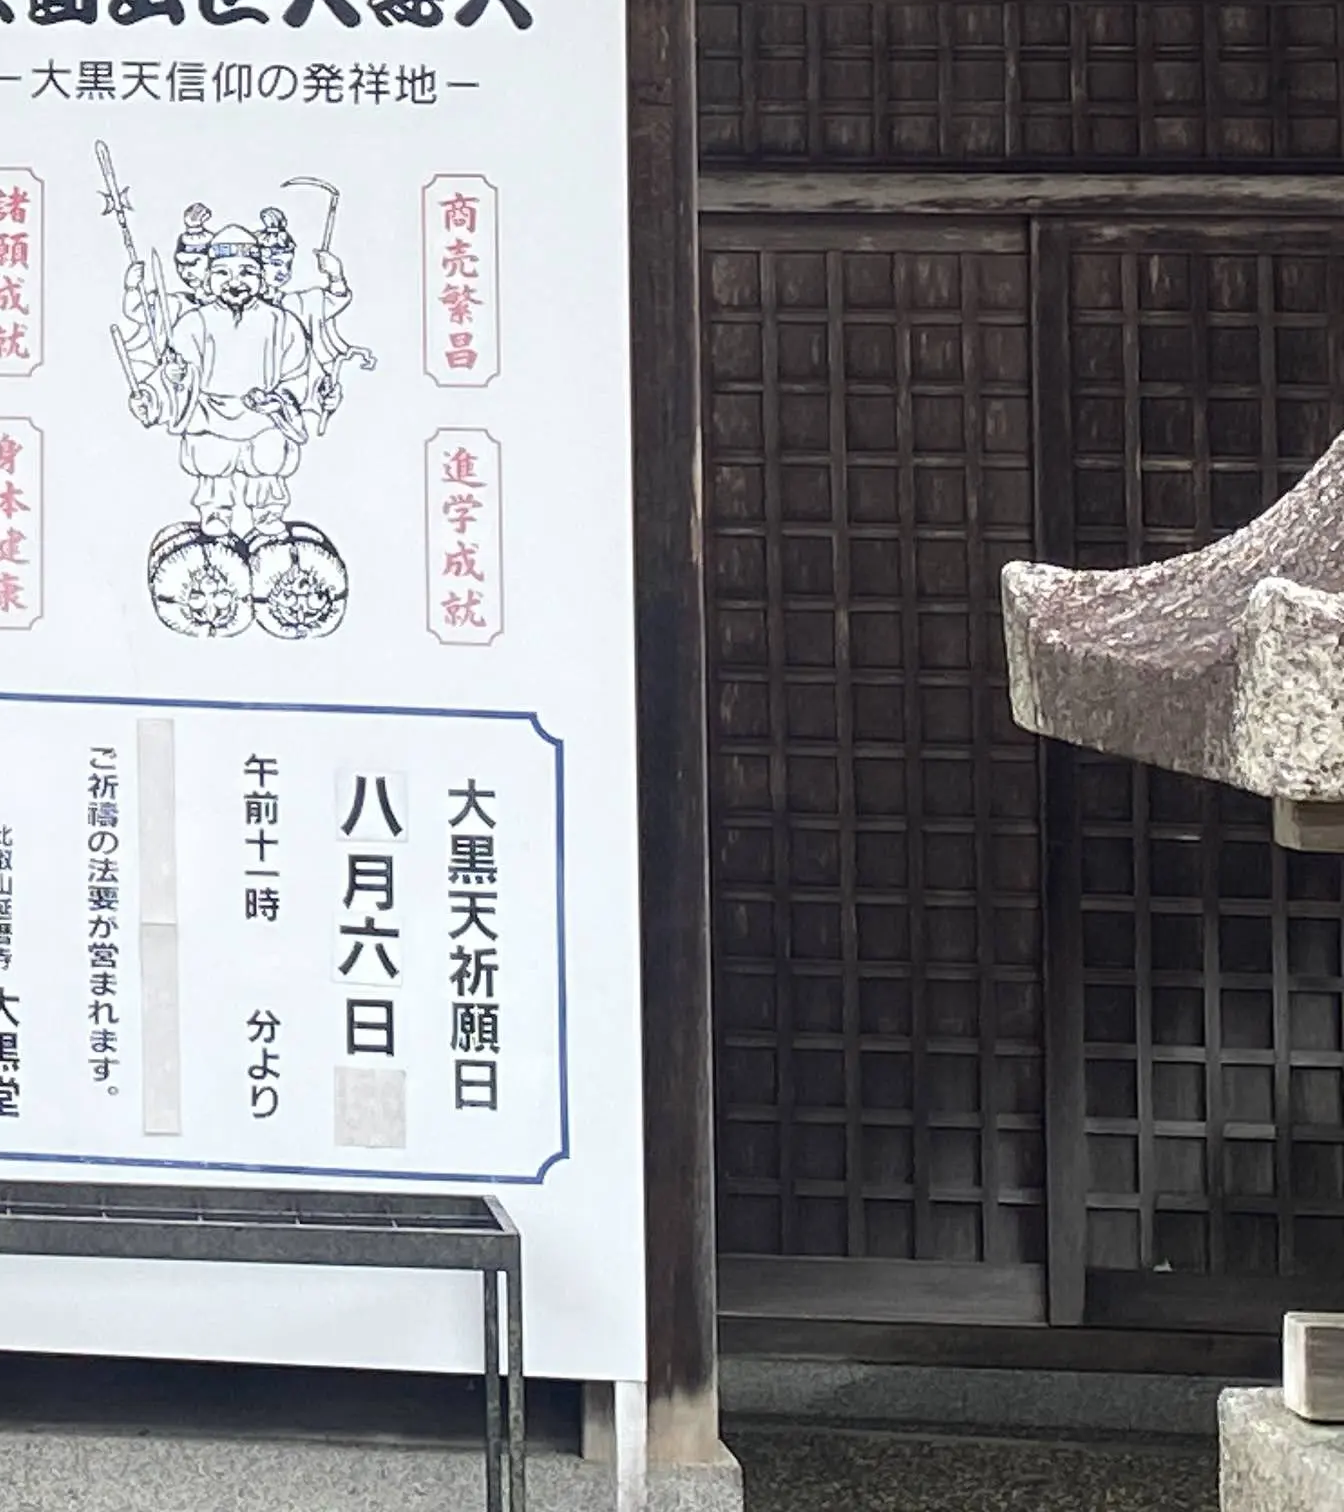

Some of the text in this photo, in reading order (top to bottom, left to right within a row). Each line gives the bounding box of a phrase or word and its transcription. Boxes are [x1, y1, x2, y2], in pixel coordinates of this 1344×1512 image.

[438, 191, 483, 370] 商売繁昌
[440, 446, 487, 628] 進学成就
[243, 753, 281, 1119] 午前十一時 分より
[339, 774, 403, 1058] 八月六日
[448, 778, 500, 1112] 大黒天祈願日
